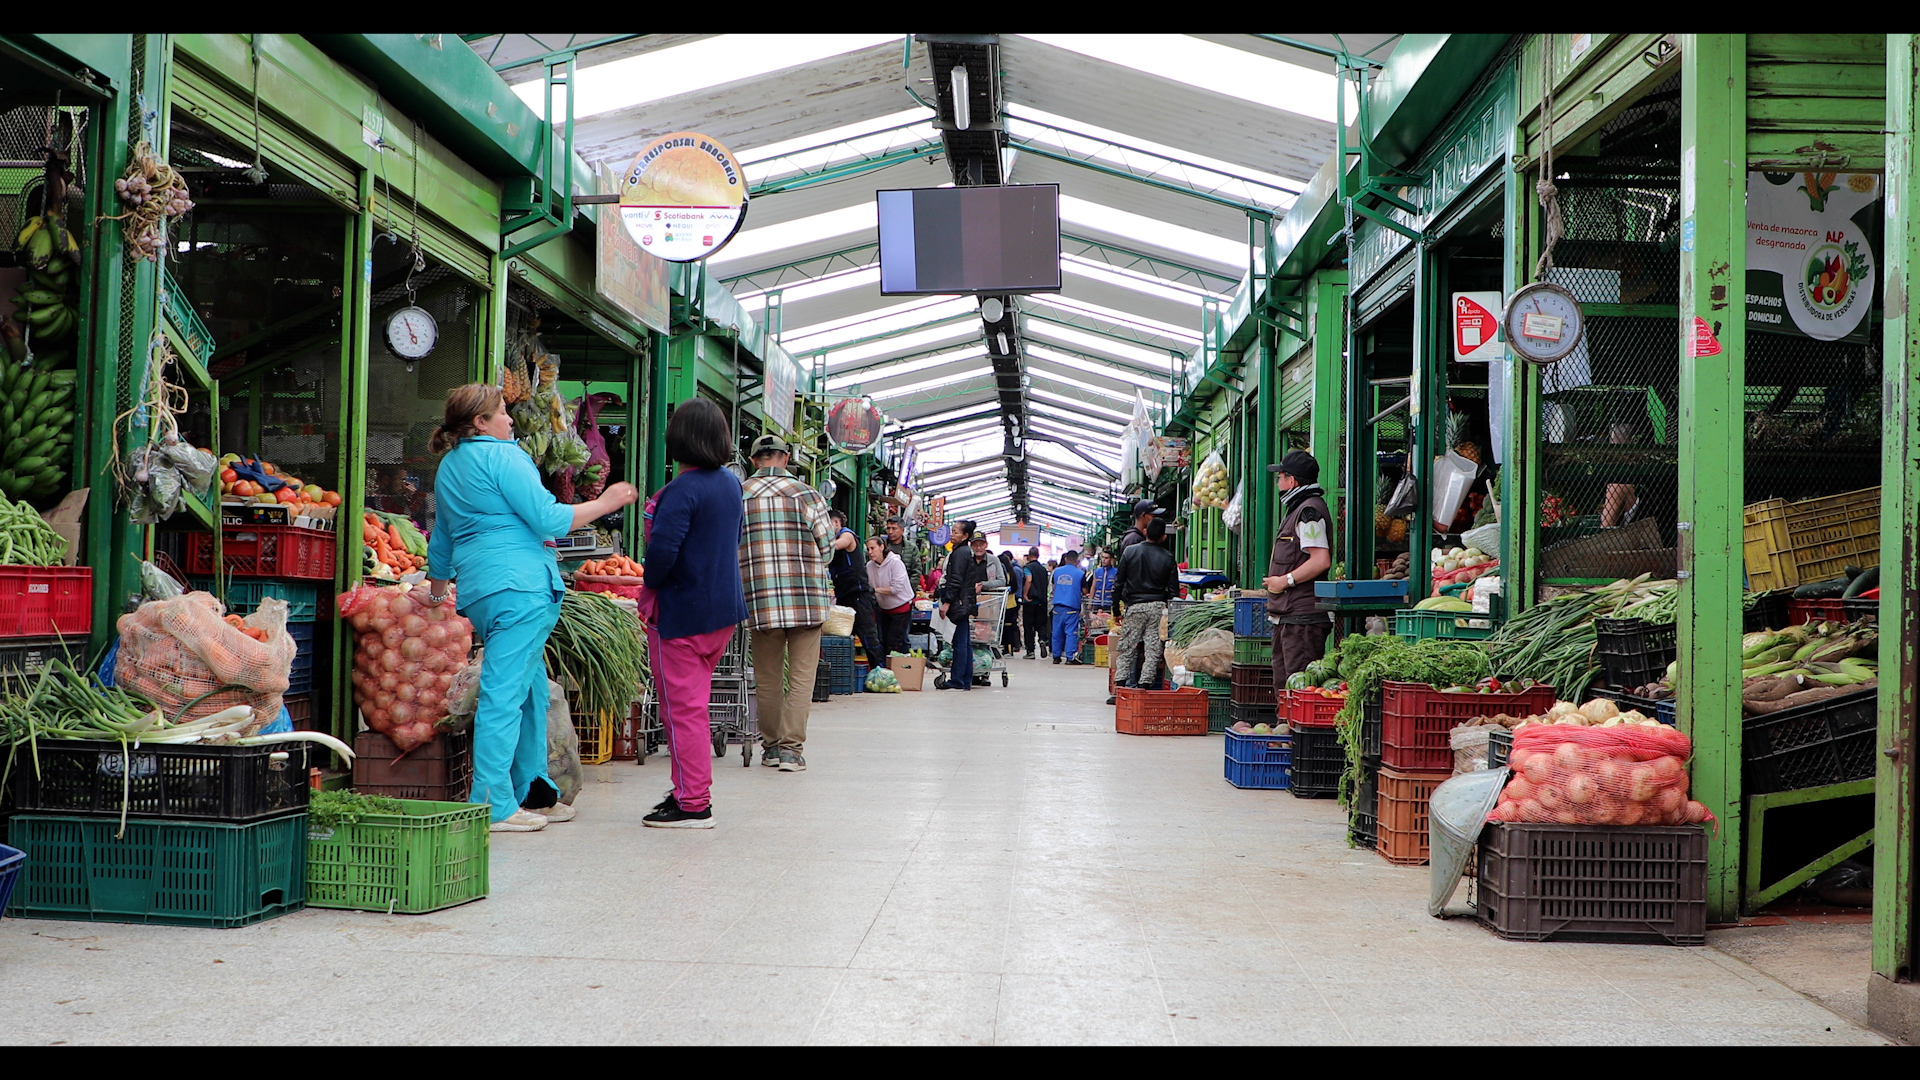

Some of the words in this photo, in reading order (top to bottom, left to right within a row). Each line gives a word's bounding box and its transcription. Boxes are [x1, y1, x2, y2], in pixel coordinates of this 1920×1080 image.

[664, 212, 705, 220] Scotiabank
[1747, 220, 1769, 232] Venta
[1770, 223, 1781, 233] de
[1781, 226, 1818, 237] mazorca
[1826, 230, 1844, 243] ALP
[1756, 237, 1806, 251] desgranada
[1745, 294, 1783, 307] ESPACHOS
[1798, 282, 1825, 321] DISTRIBUIDORA
[1825, 313, 1833, 321] DE
[1833, 290, 1857, 320] VERDURAS
[1748, 311, 1782, 324] DOMICILIO
